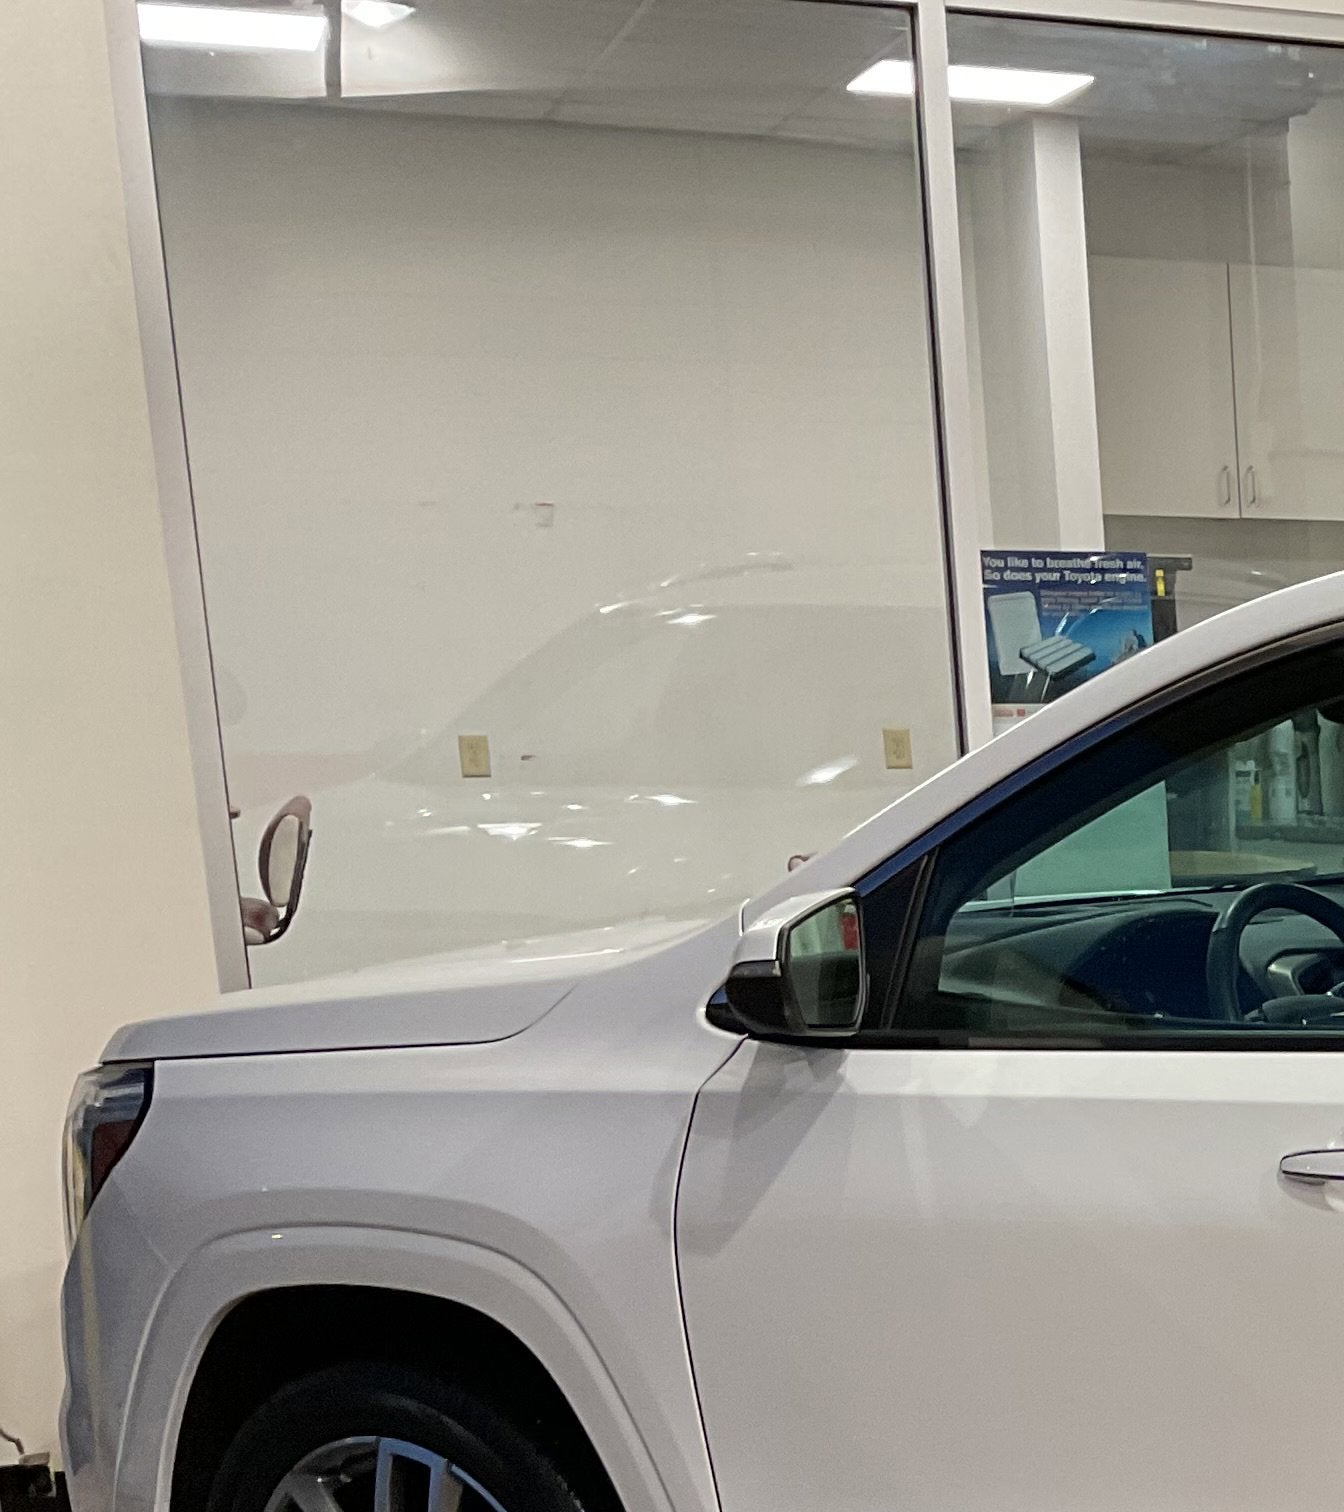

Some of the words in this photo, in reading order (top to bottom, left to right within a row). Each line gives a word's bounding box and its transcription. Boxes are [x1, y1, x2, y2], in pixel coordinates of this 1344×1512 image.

[983, 556, 1004, 568] You
[1007, 556, 1029, 568] like
[1032, 557, 1044, 568] to
[984, 569, 1000, 580] So
[1003, 570, 1033, 581] does
[1035, 571, 1061, 584] your
[1063, 570, 1102, 584] Toyota
